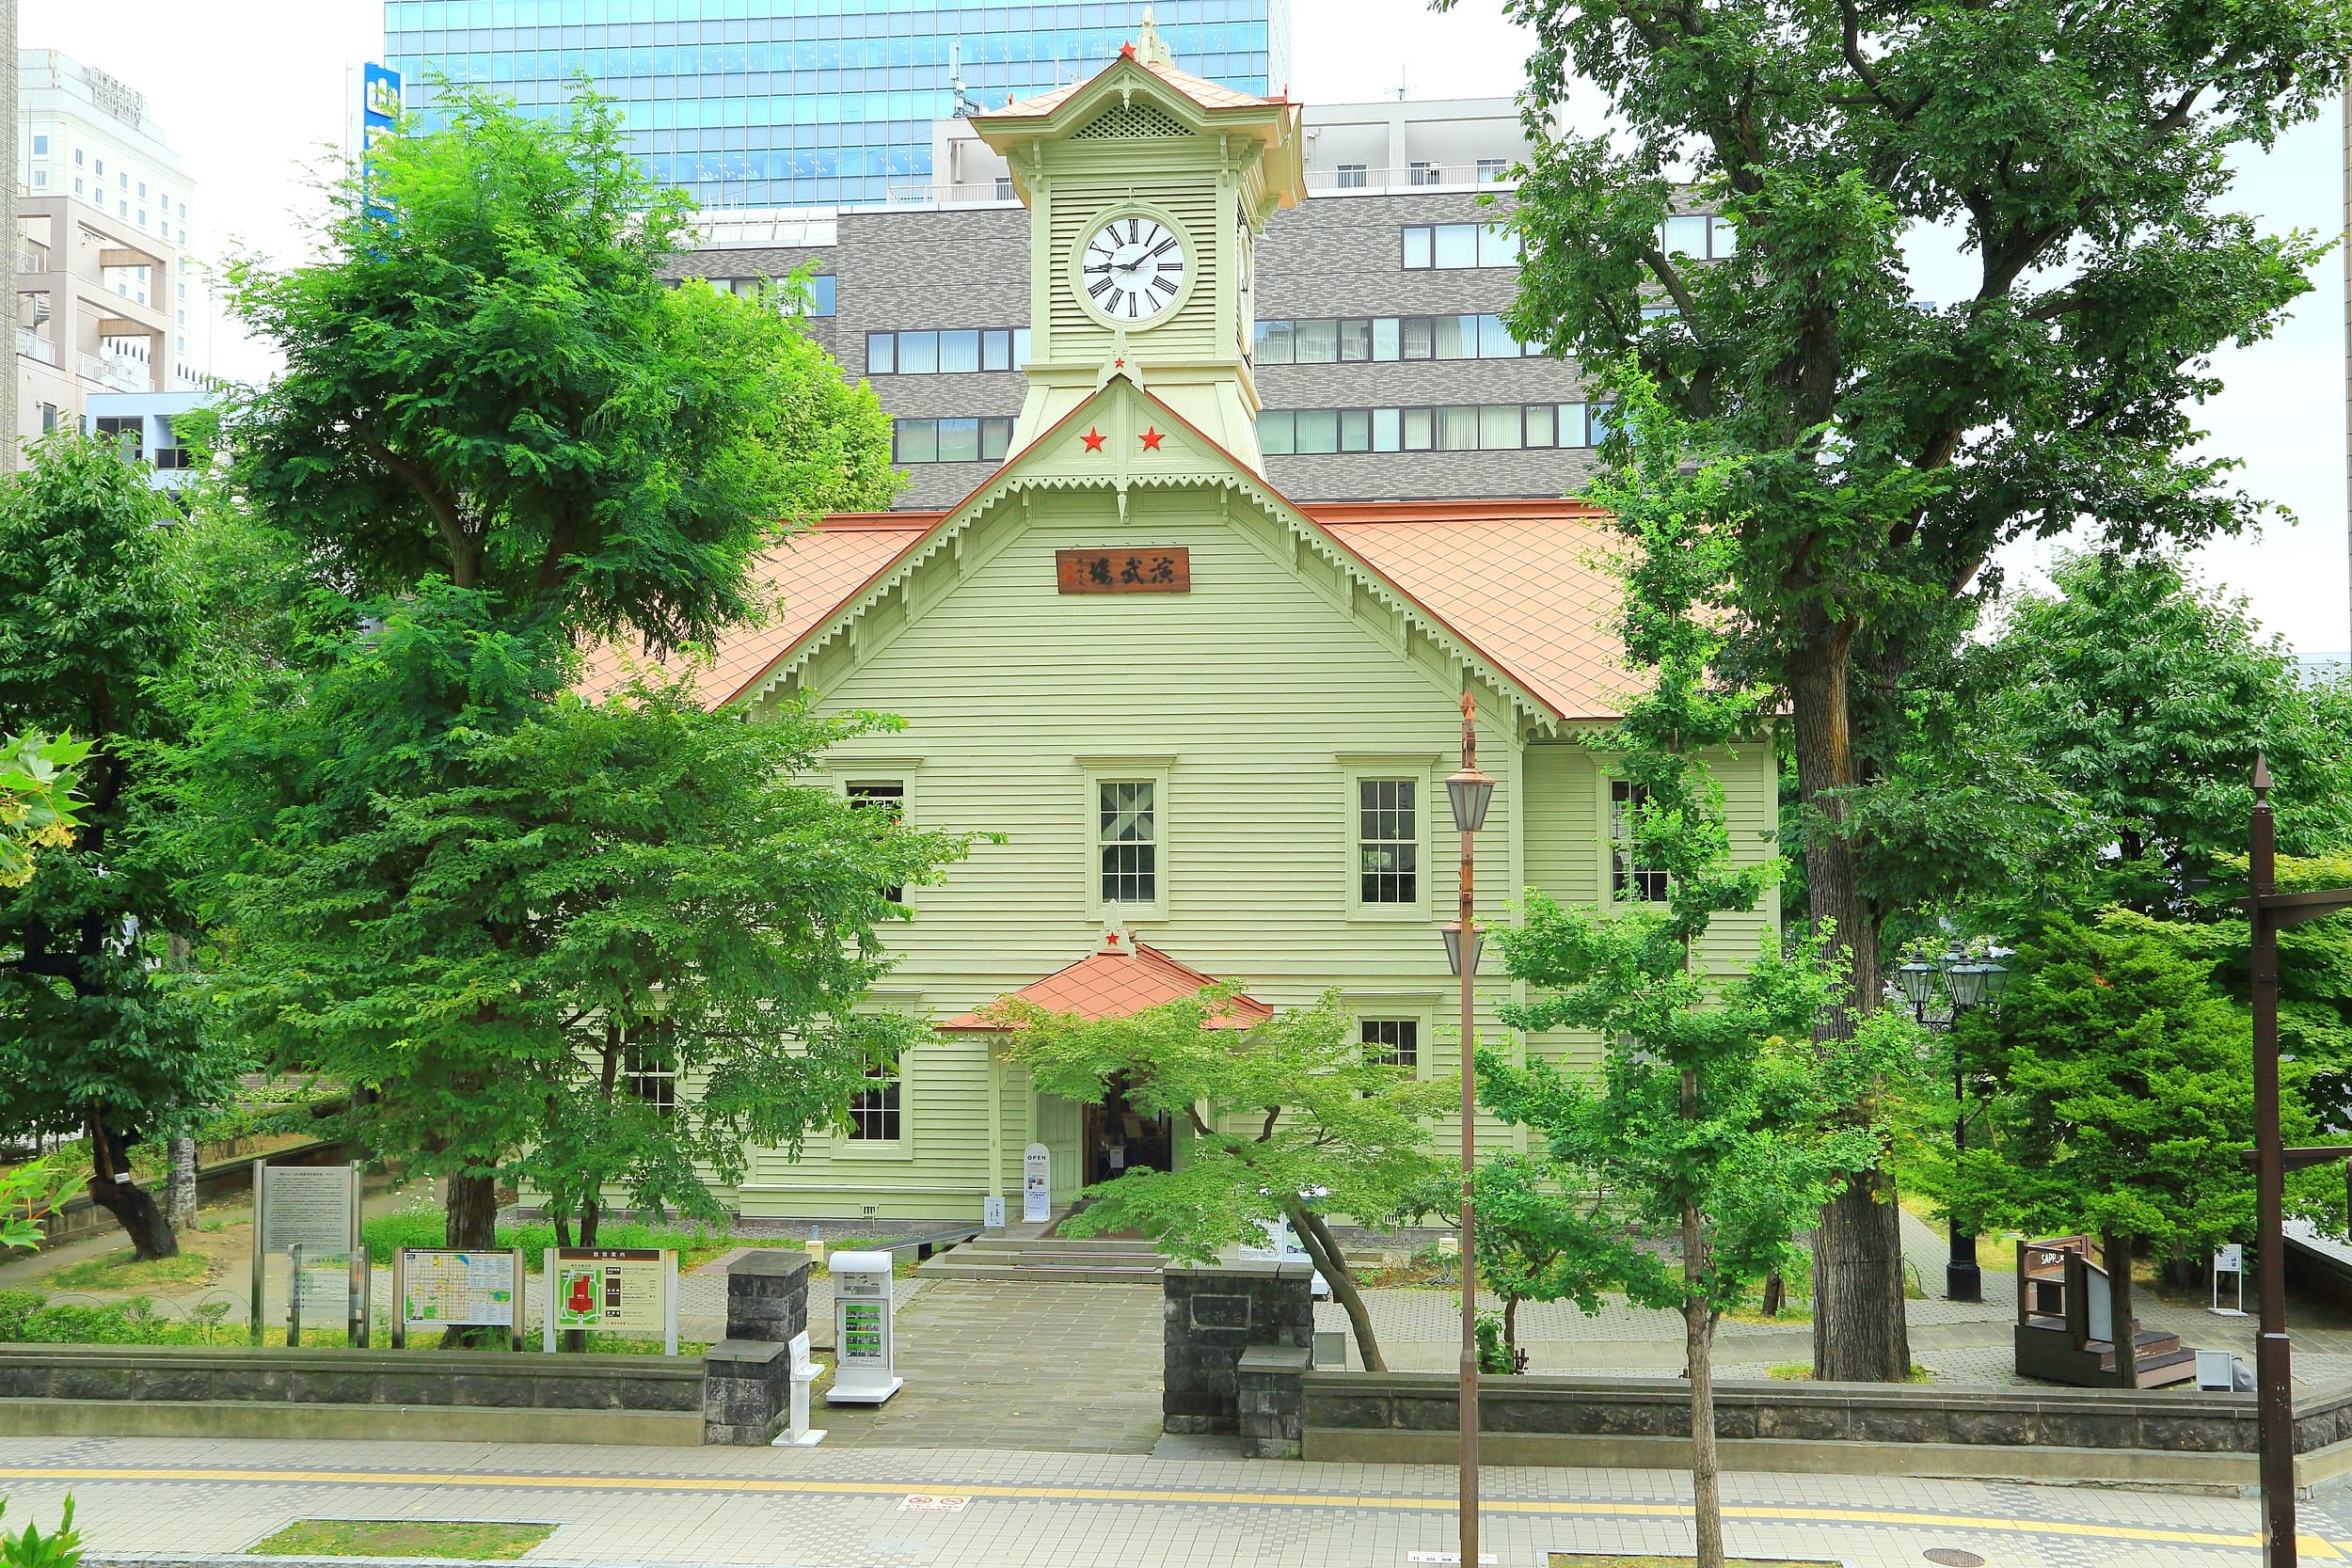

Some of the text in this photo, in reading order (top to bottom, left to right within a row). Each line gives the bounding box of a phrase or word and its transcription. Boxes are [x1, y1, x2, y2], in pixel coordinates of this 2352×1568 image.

[1105, 224, 1125, 249] XI
[1128, 218, 1138, 244] XII
[1144, 223, 1160, 247] I
[1089, 241, 1114, 261] X
[1157, 262, 1183, 271] III
[1104, 288, 1124, 313] VII
[1128, 292, 1137, 317] VI
[1145, 288, 1161, 312] V
